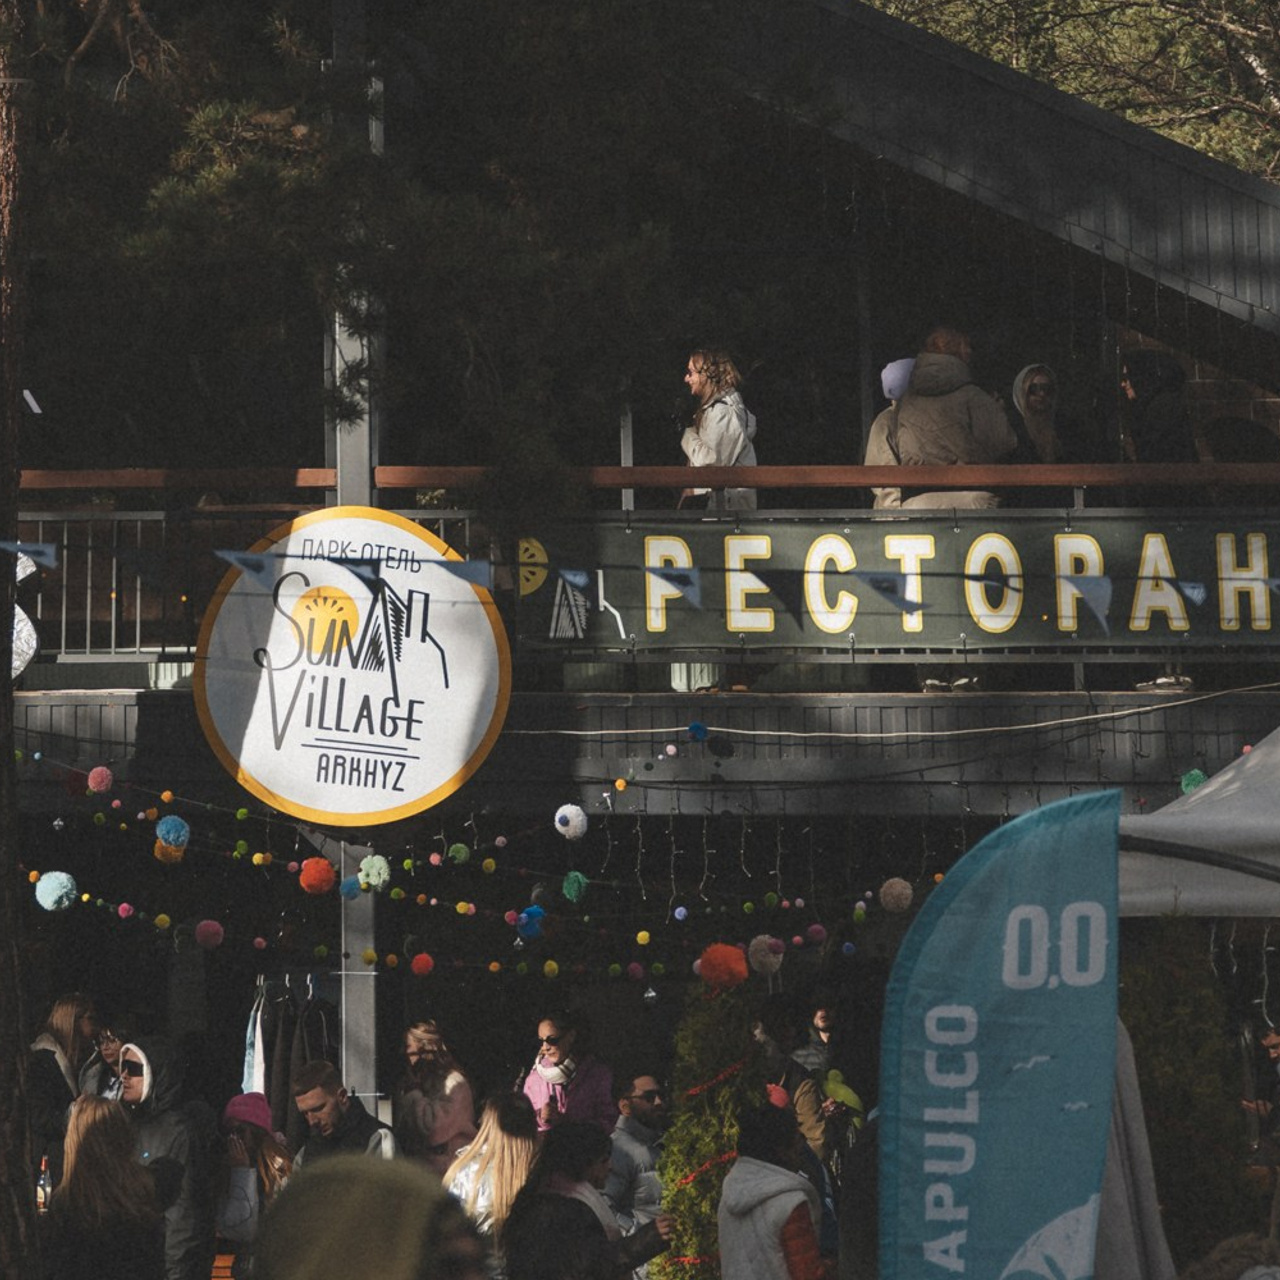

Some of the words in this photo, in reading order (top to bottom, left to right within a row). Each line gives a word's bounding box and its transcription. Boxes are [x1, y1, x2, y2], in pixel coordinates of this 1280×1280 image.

[300, 538, 422, 574] ПАРК-ОТЕЛЬ
[644, 533, 1273, 633] РЕСТОРАН
[316, 753, 407, 792] ARKHYZ
